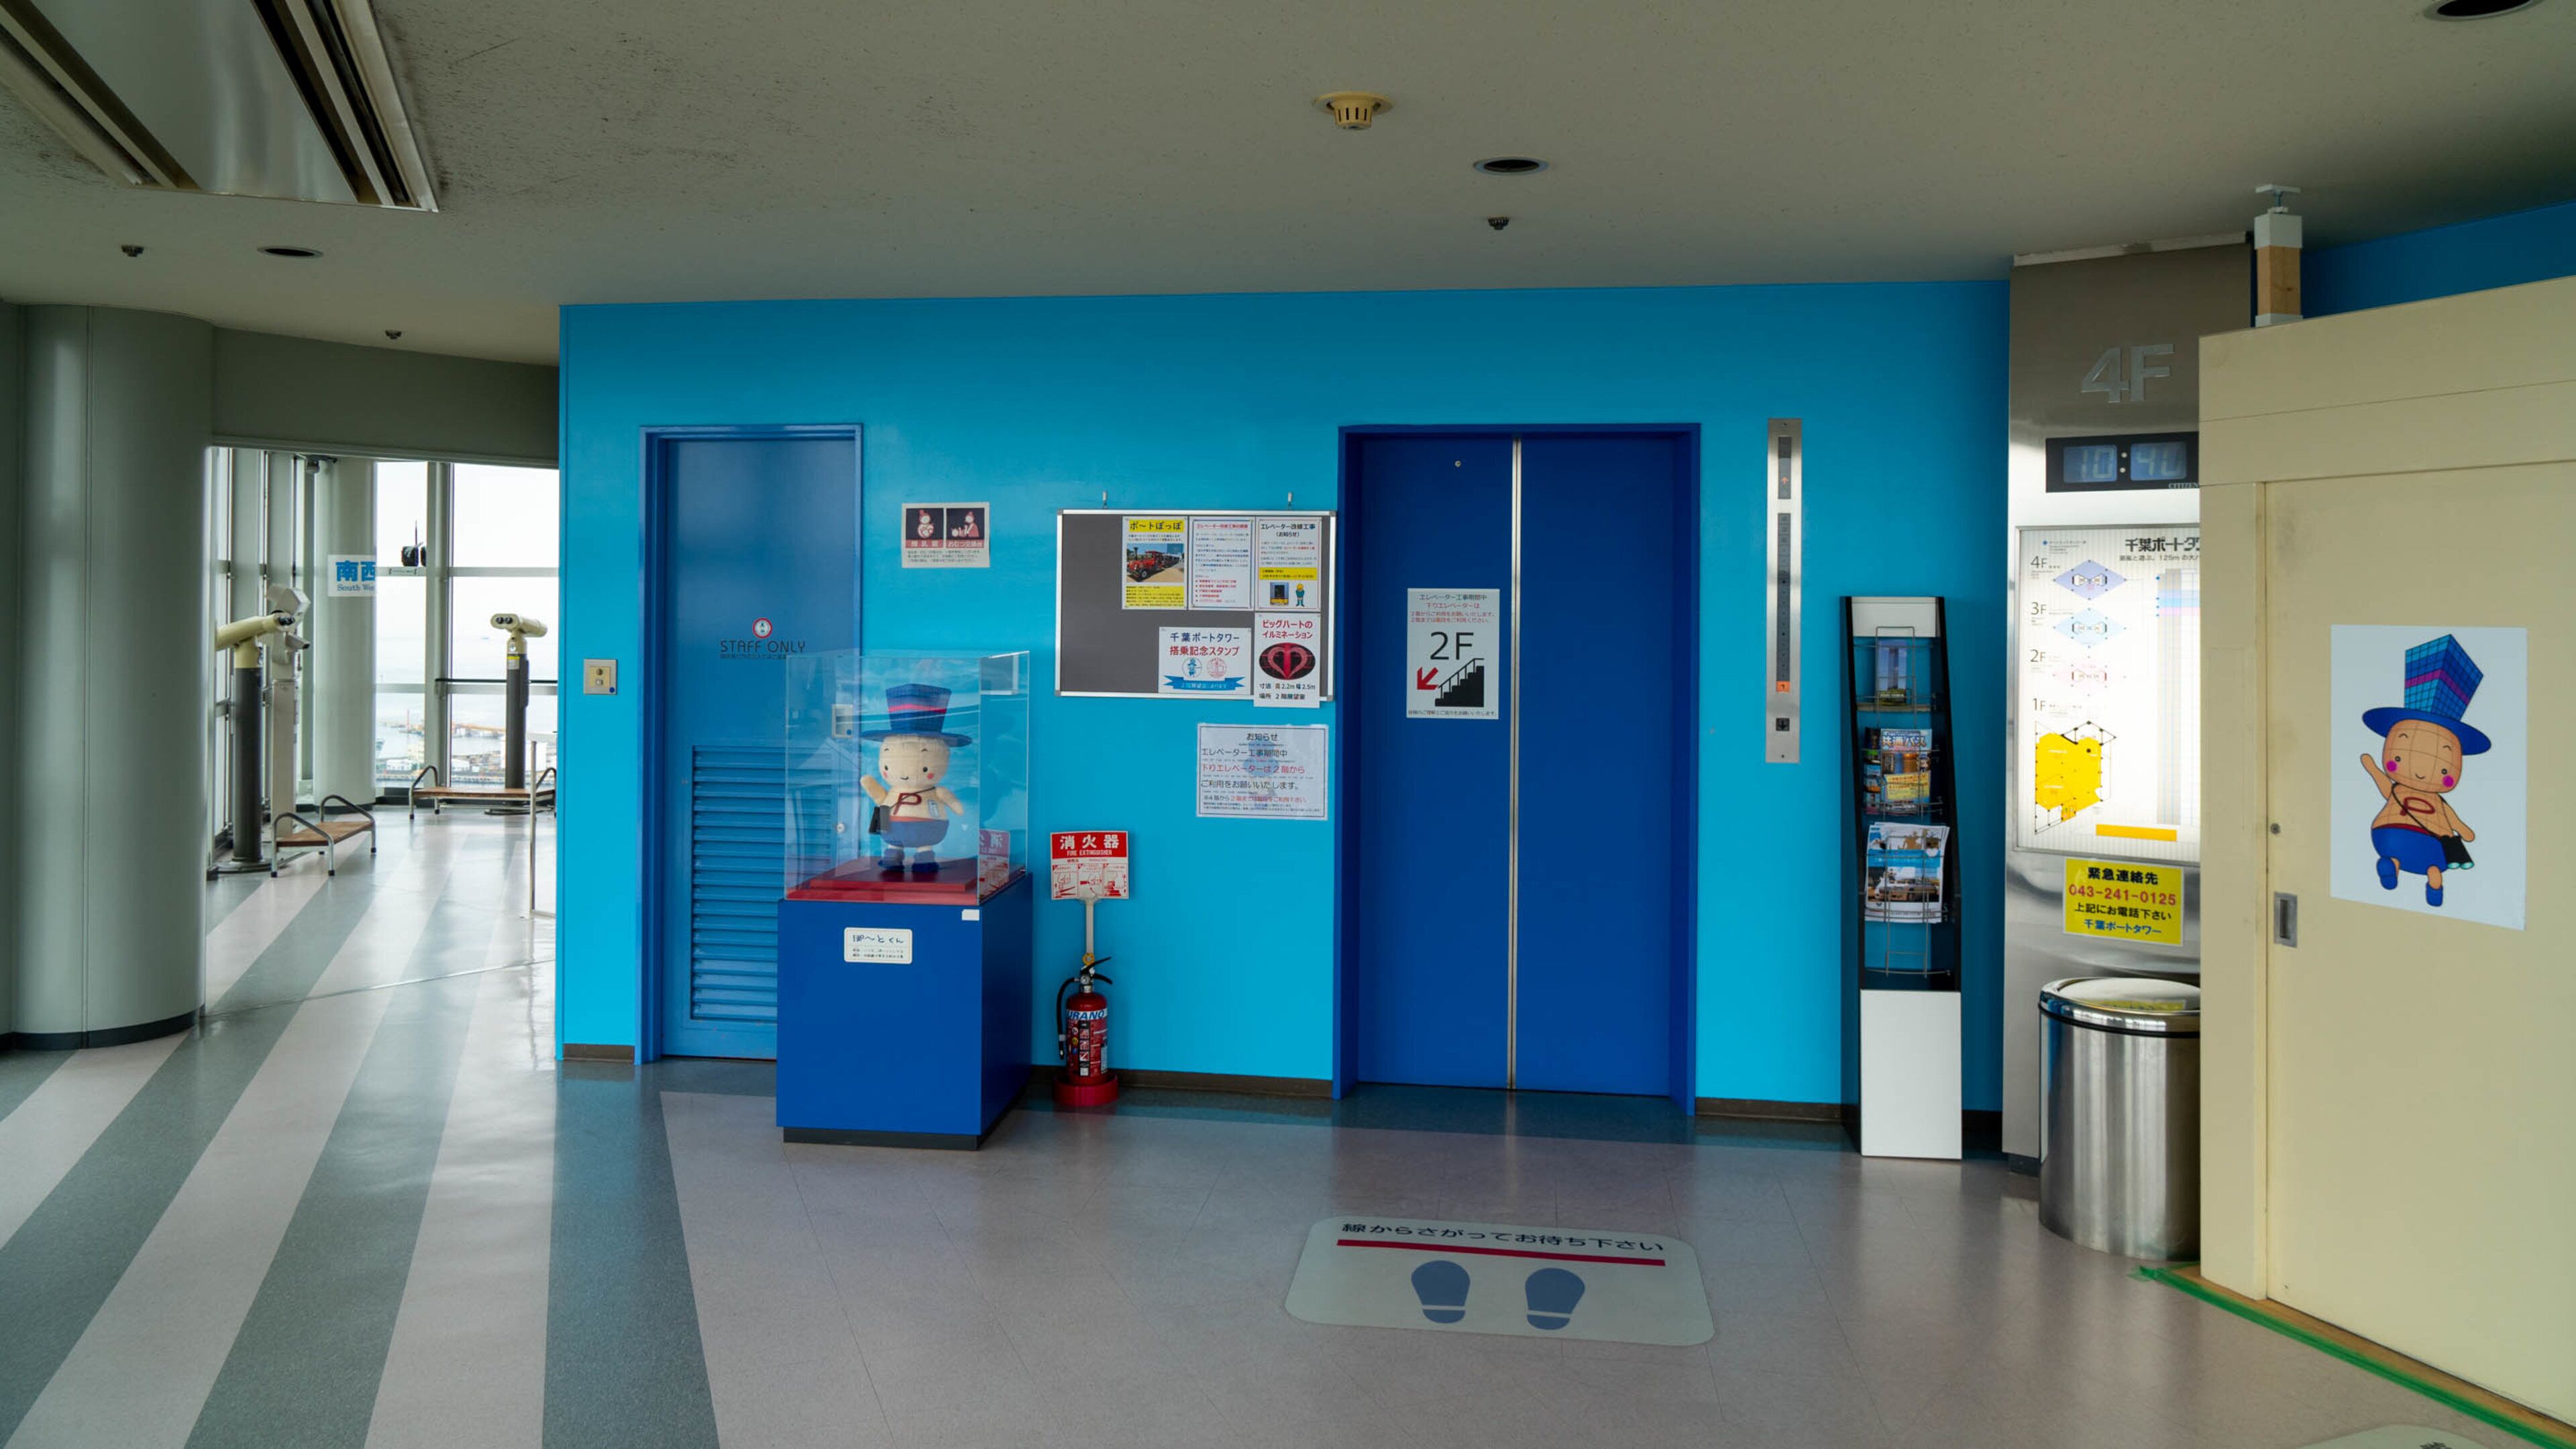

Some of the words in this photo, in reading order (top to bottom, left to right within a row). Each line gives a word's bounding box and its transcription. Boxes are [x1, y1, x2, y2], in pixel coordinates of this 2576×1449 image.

[2082, 343, 2175, 403] 4F
[2031, 556, 2047, 569] 4F
[2031, 602, 2047, 615] 3F
[1263, 619, 1313, 629] ビッグハートの
[1170, 632, 1240, 643] 千葉ポートタワー
[1263, 631, 1313, 639] イルミネーション
[720, 640, 762, 653] STAFF
[767, 640, 806, 653] ONLY
[1169, 646, 1240, 656] 搭乗記念スタンプ
[1430, 631, 1474, 660] 2F
[2031, 649, 2046, 662] 2F
[2033, 698, 2046, 711] 1F
[1246, 733, 1278, 741] お知らせ
[1201, 749, 1288, 757] エレベーター工事期間中
[1060, 835, 1120, 850] 消火器
[2088, 867, 2158, 885] 緊急連絡先
[2069, 883, 2176, 906] 043-241-0125
[2075, 902, 2172, 920] 上記にお電話下さい
[2084, 919, 2161, 934] 千葉ポートタワー
[1342, 1223, 1664, 1252] 線からさがってお待ち下さい
